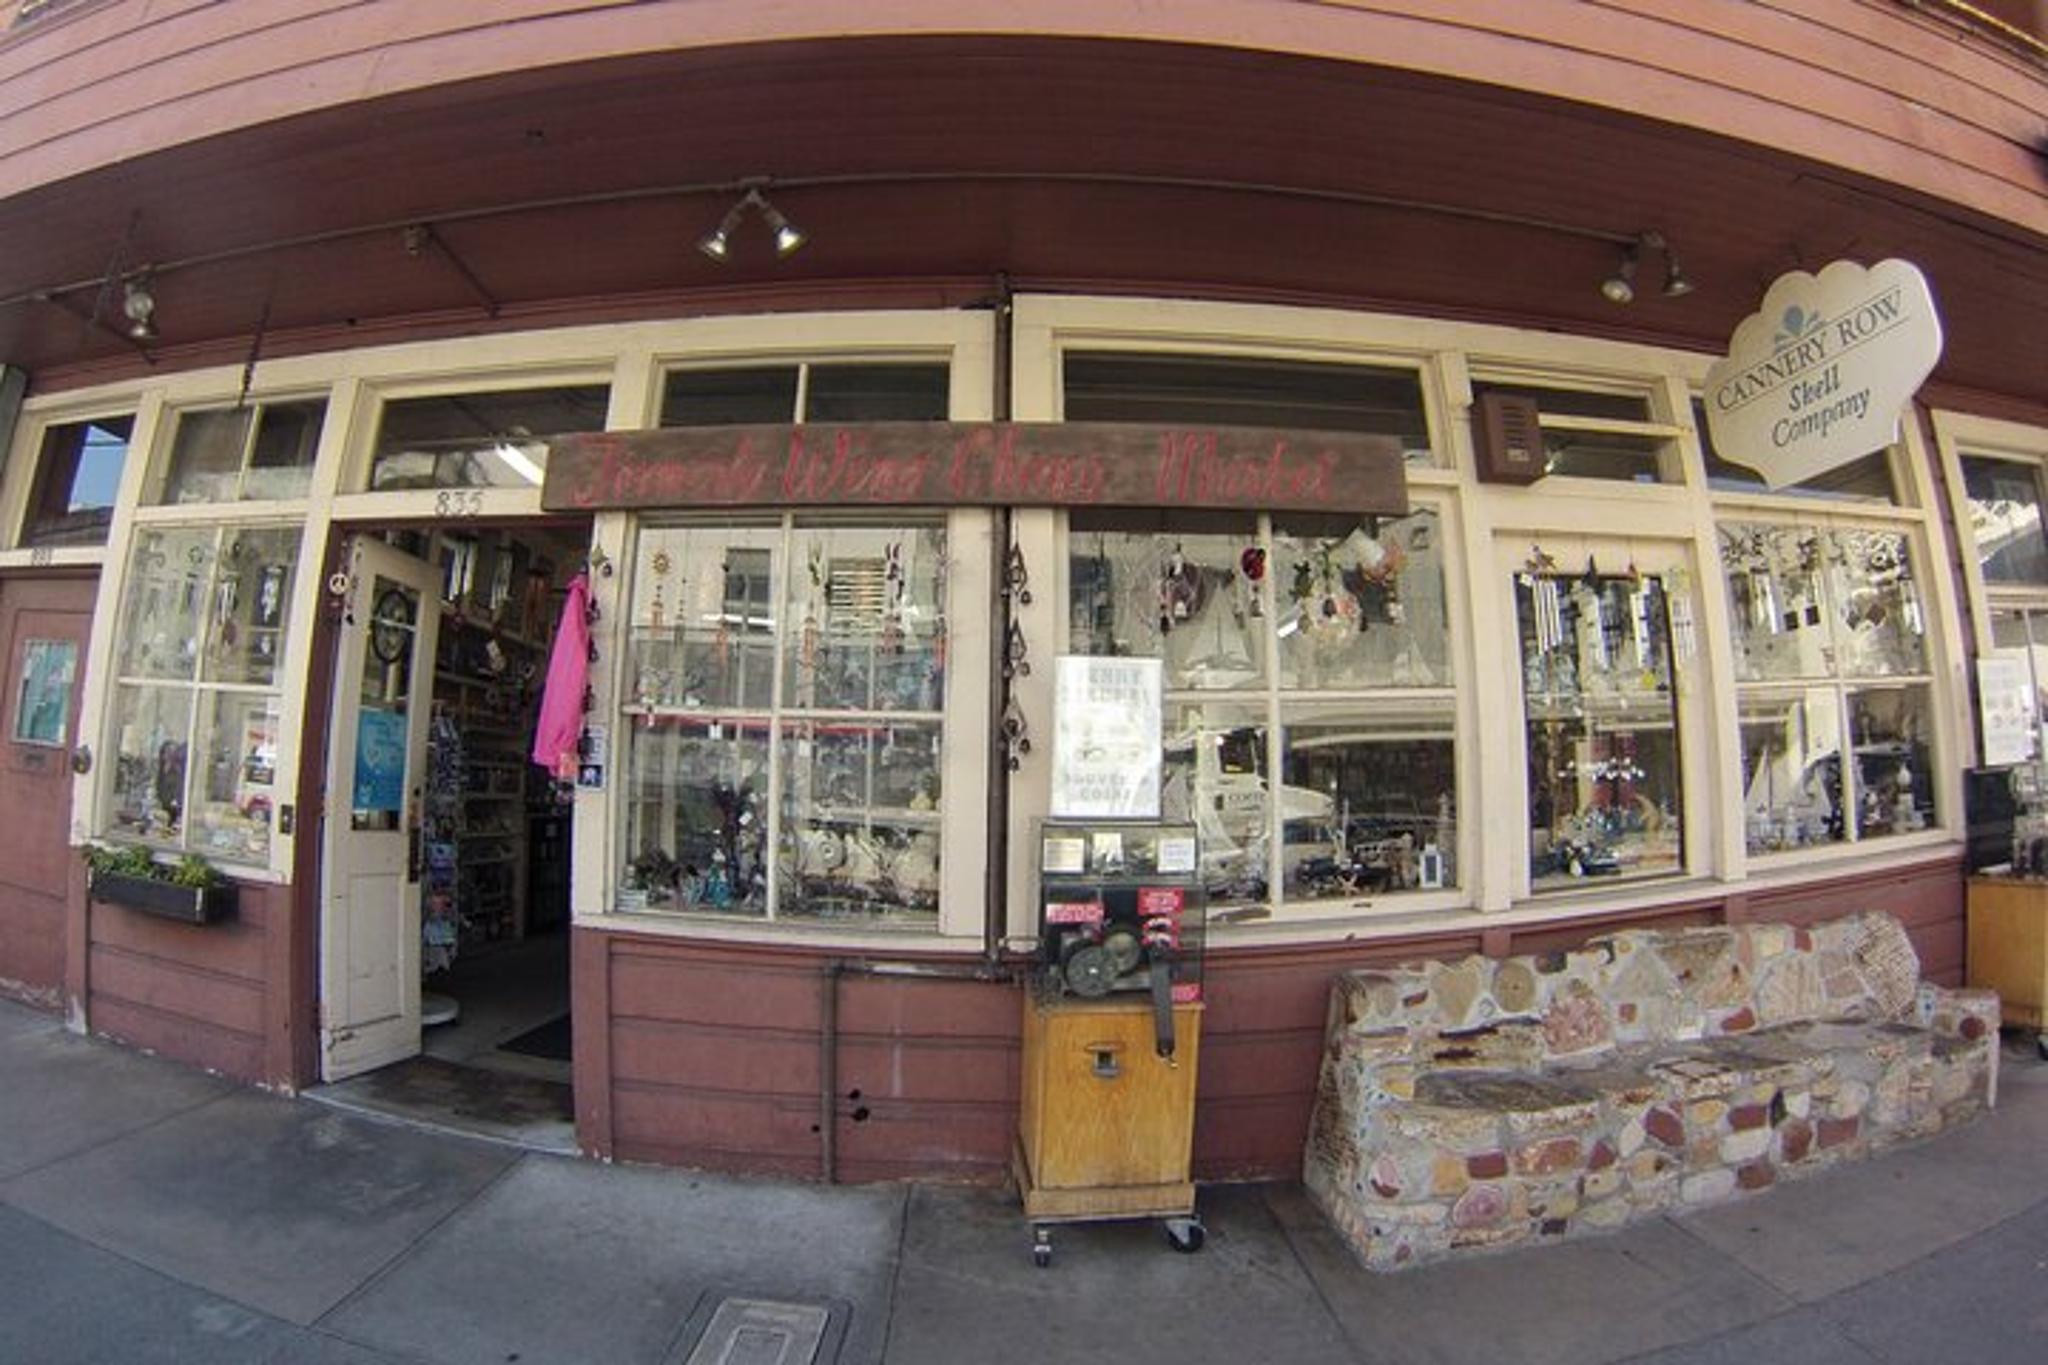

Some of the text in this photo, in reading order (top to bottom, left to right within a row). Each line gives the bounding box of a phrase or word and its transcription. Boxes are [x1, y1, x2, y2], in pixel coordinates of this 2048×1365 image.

[1716, 290, 1901, 410] CANNERY ROW
[1789, 364, 1841, 411] Shell
[1772, 388, 1870, 448] Company
